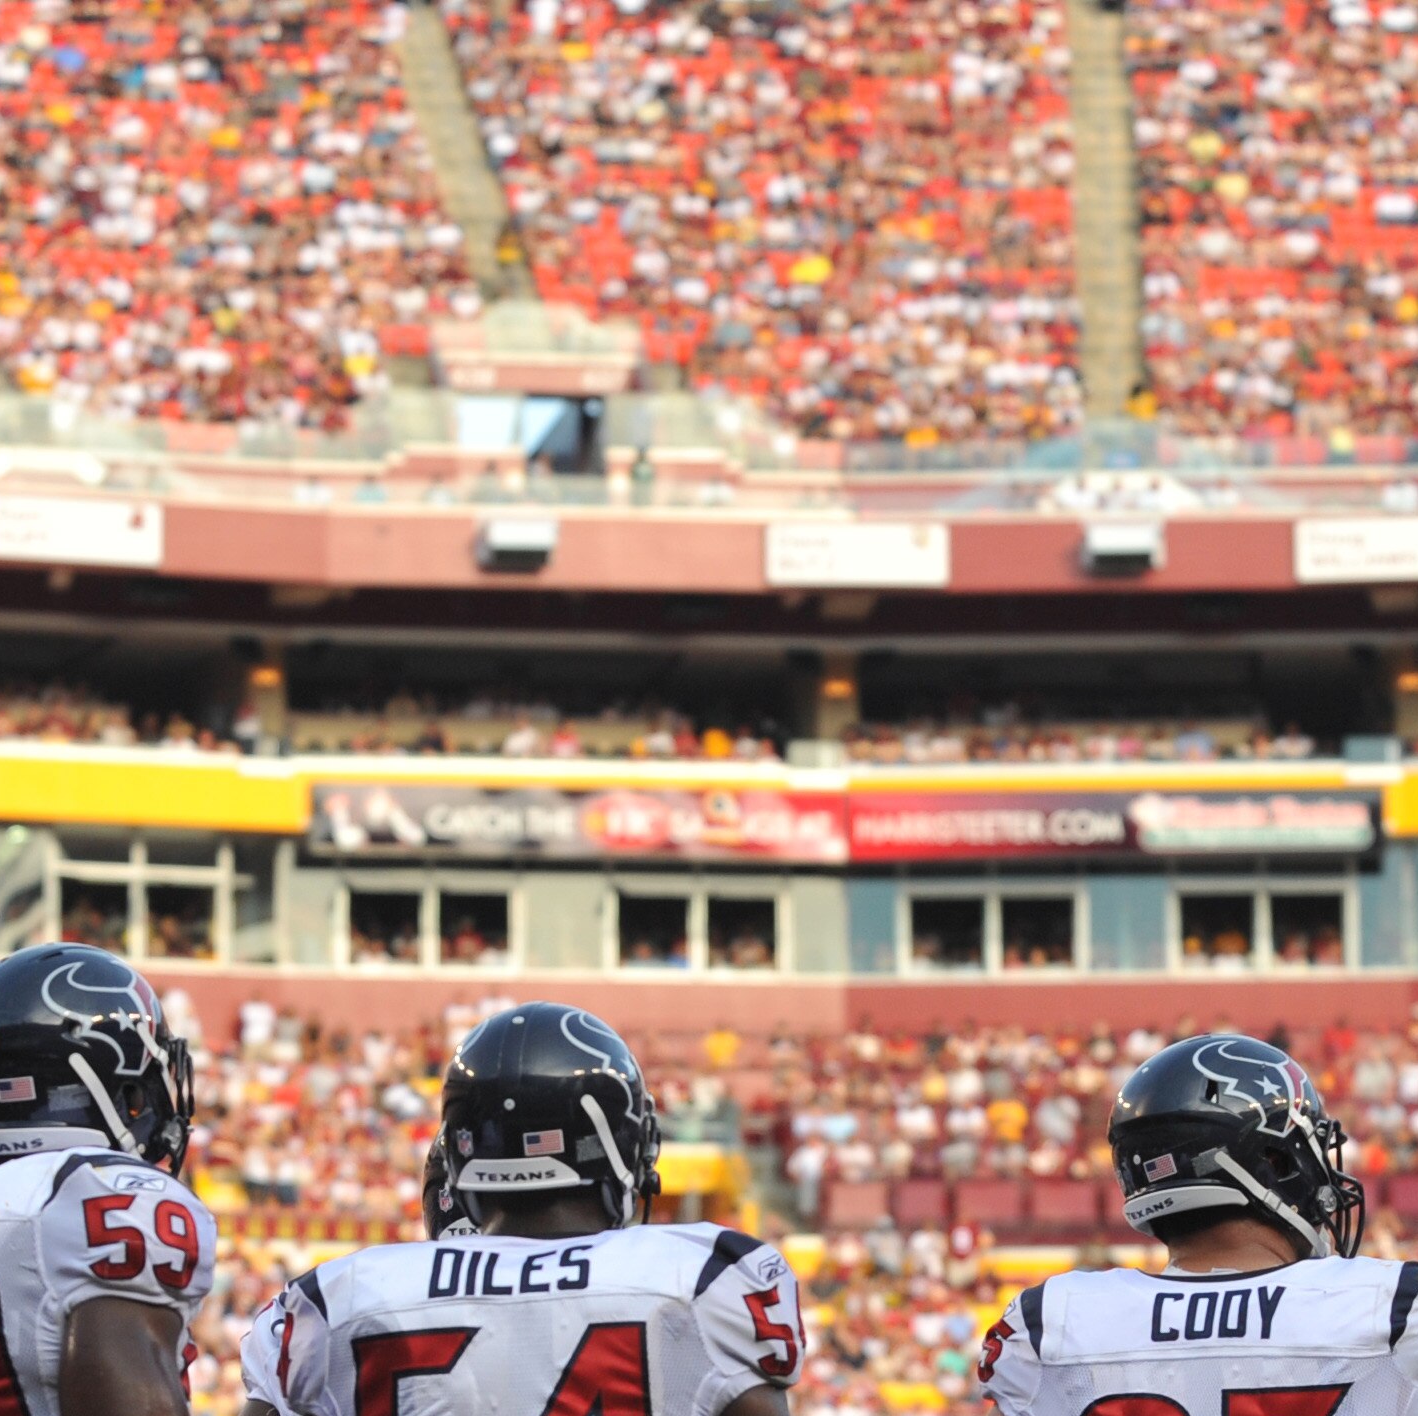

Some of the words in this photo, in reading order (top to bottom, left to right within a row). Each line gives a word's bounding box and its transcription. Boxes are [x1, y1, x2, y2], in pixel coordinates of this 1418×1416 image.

[474, 1169, 557, 1182] TEXANS
[83, 1195, 200, 1289] 59
[448, 1226, 480, 1237] TEX
[427, 1244, 595, 1299] DILES
[743, 1281, 807, 1377] 5
[1150, 1286, 1287, 1342] CODY
[977, 1318, 1018, 1384] 5
